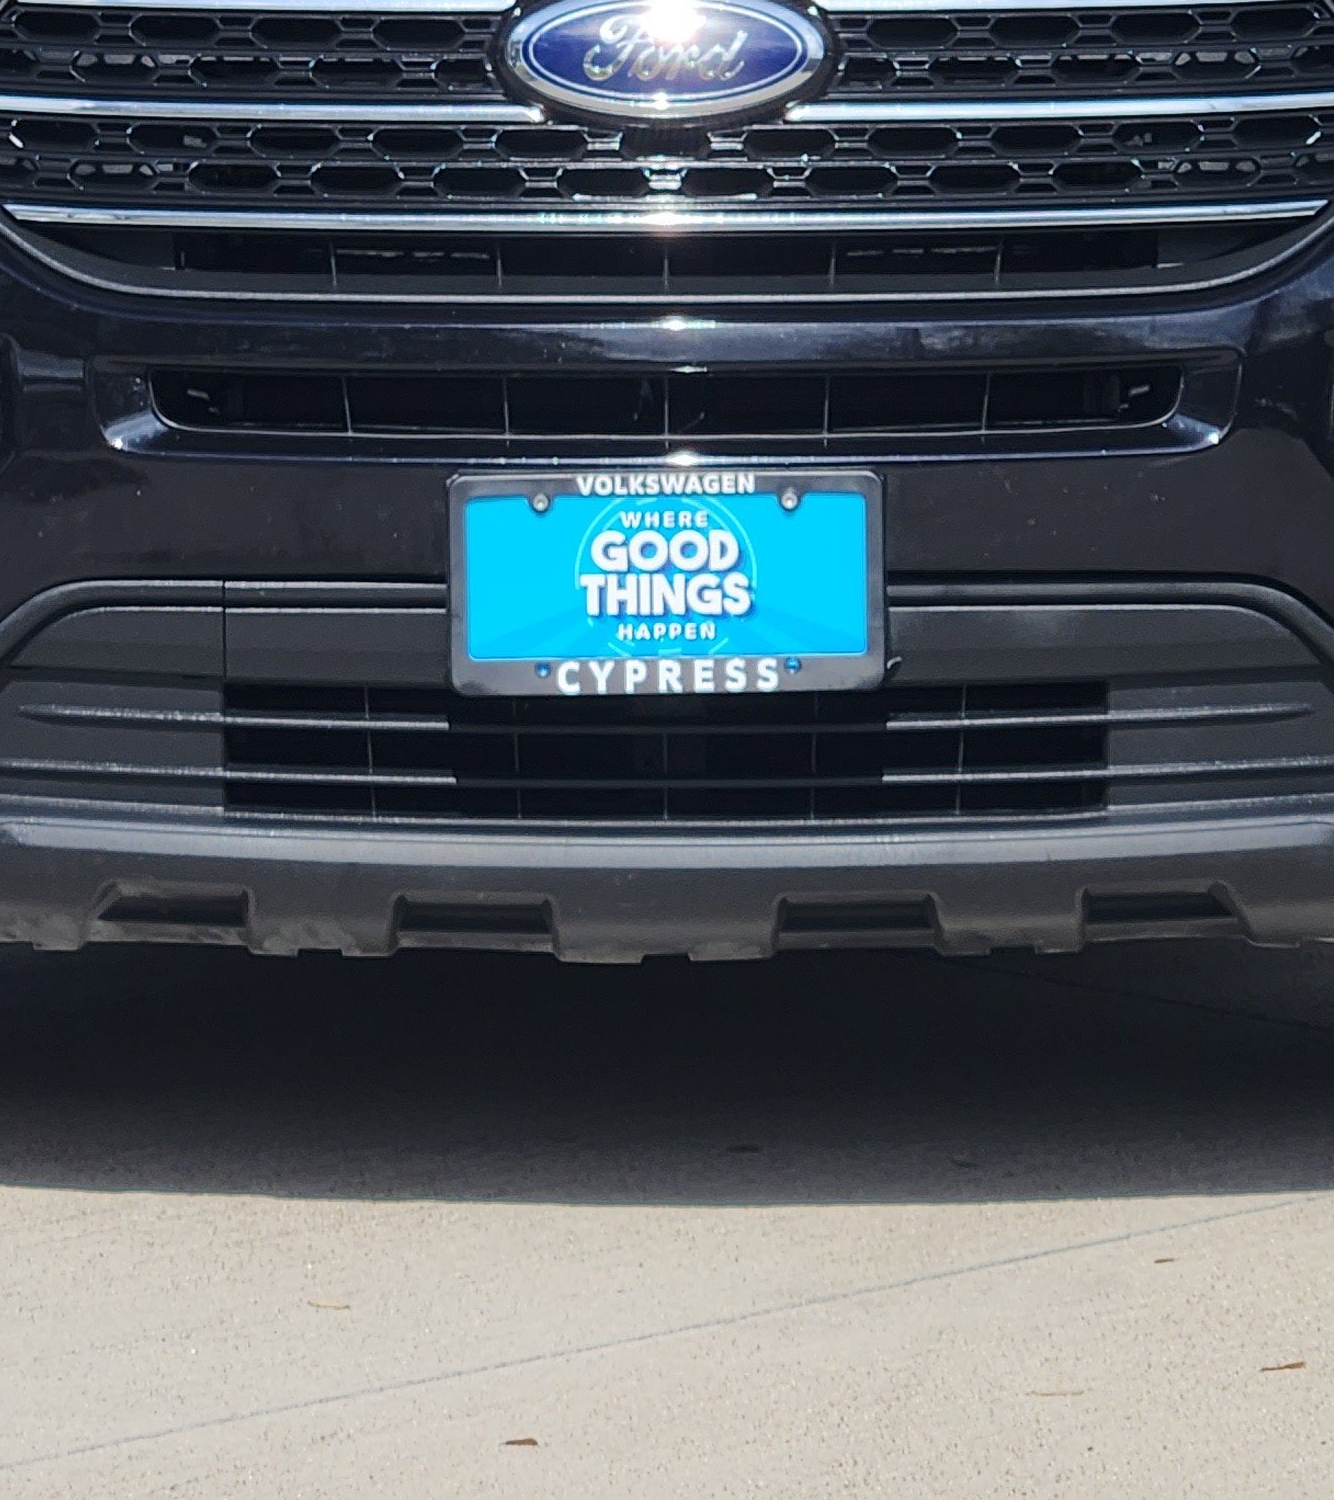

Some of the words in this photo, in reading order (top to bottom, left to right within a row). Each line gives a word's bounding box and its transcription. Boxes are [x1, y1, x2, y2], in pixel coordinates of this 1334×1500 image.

[583, 12, 749, 81] Ford
[576, 473, 756, 496] VOLKSWAGEN
[620, 511, 709, 528] WHERE
[590, 529, 740, 572] GOOD
[579, 572, 753, 616] THINGS
[617, 622, 717, 640] HAPPEN
[555, 657, 780, 694] CYPRESS
